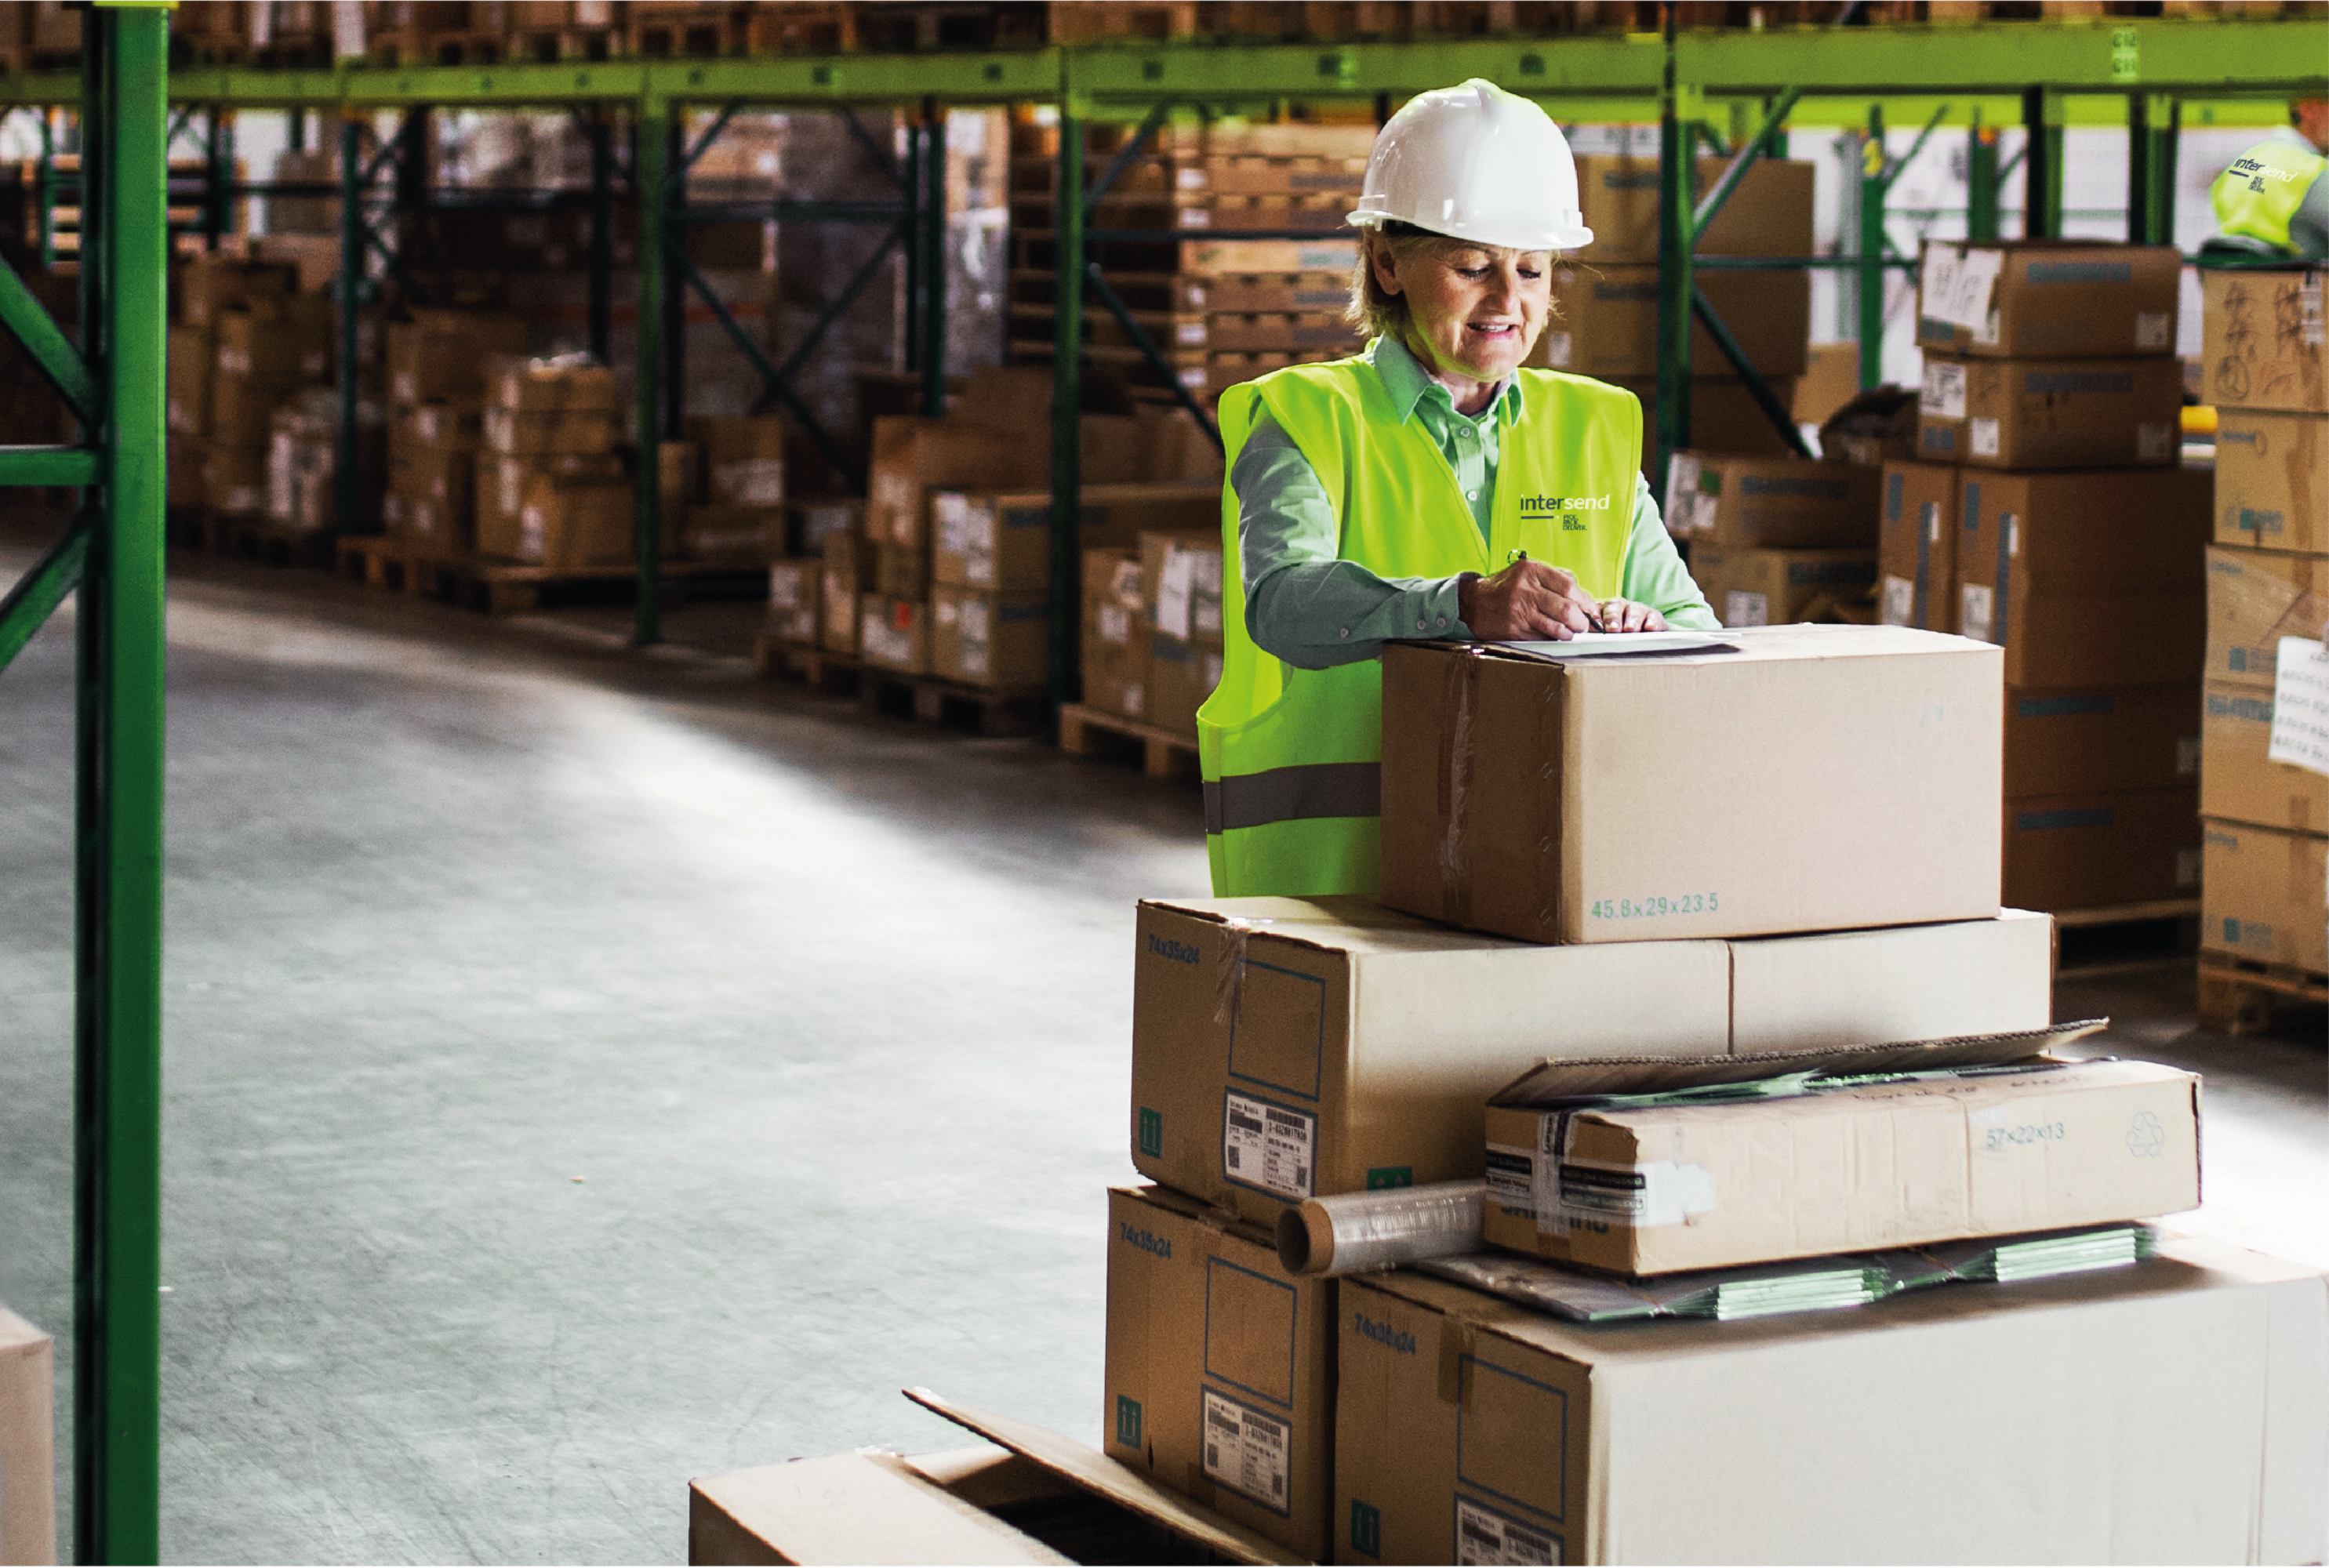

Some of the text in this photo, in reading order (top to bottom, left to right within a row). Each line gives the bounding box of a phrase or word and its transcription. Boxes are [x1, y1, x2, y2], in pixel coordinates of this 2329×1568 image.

[2233, 156, 2298, 183] intersend
[1521, 494, 1610, 510] intersend
[1591, 892, 1719, 919] 45.8x29x23.5
